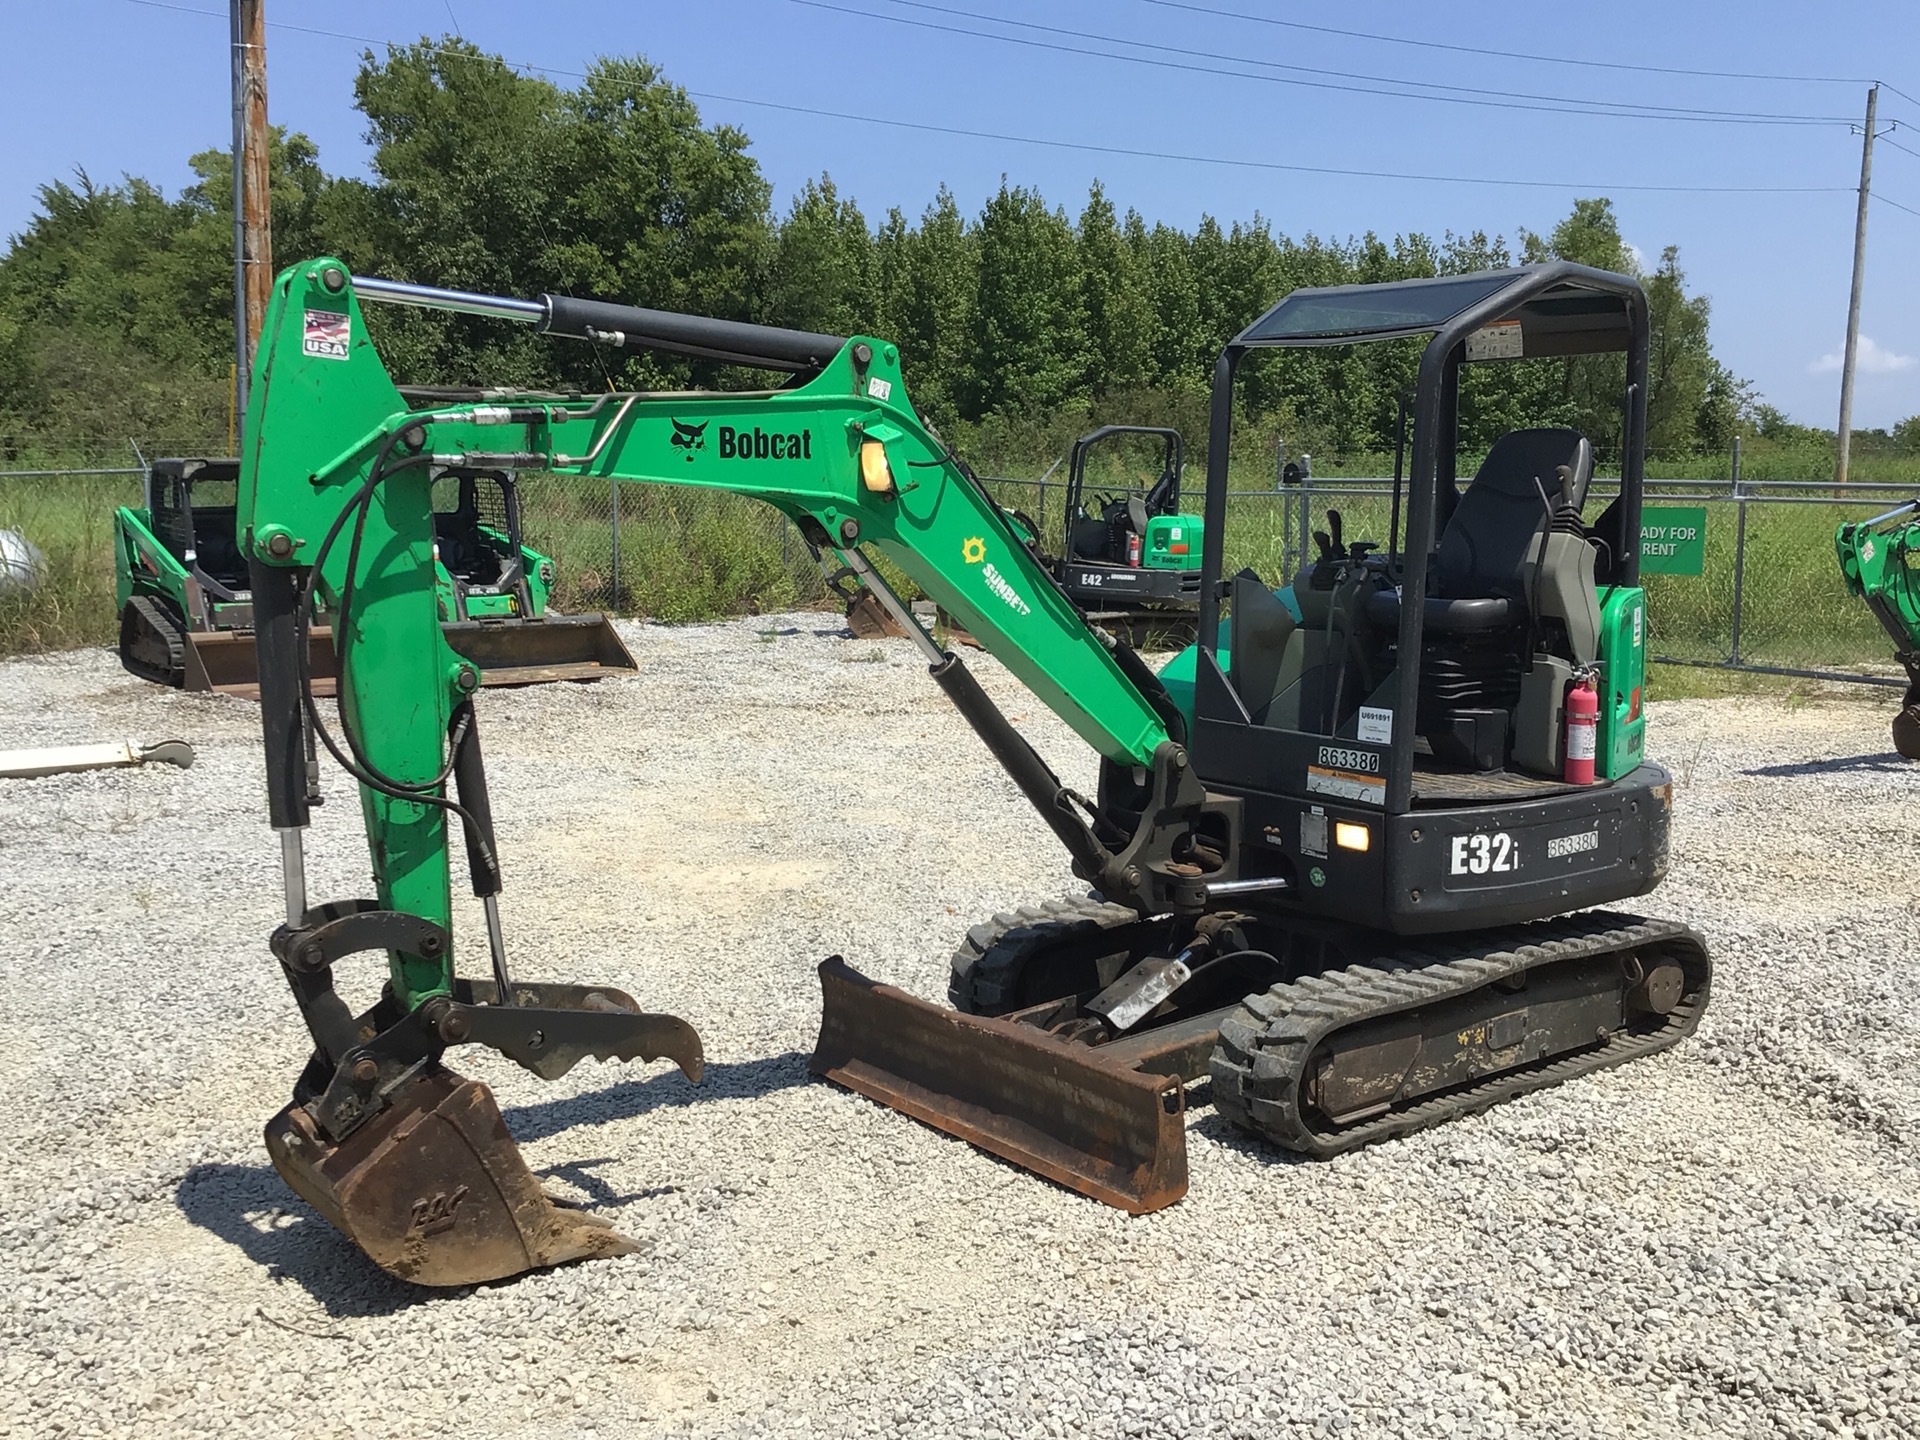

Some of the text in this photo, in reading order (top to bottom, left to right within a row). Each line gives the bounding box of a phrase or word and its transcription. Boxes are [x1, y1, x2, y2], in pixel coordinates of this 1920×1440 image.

[306, 340, 346, 355] USA
[719, 426, 811, 459] Bobcat
[1640, 526, 1696, 540] ADY FOR
[1642, 542, 1677, 556] RENT
[1081, 573, 1102, 586] E42
[1320, 747, 1378, 772] 863380
[1451, 833, 1518, 874] E32i
[1549, 832, 1597, 857] 863380
